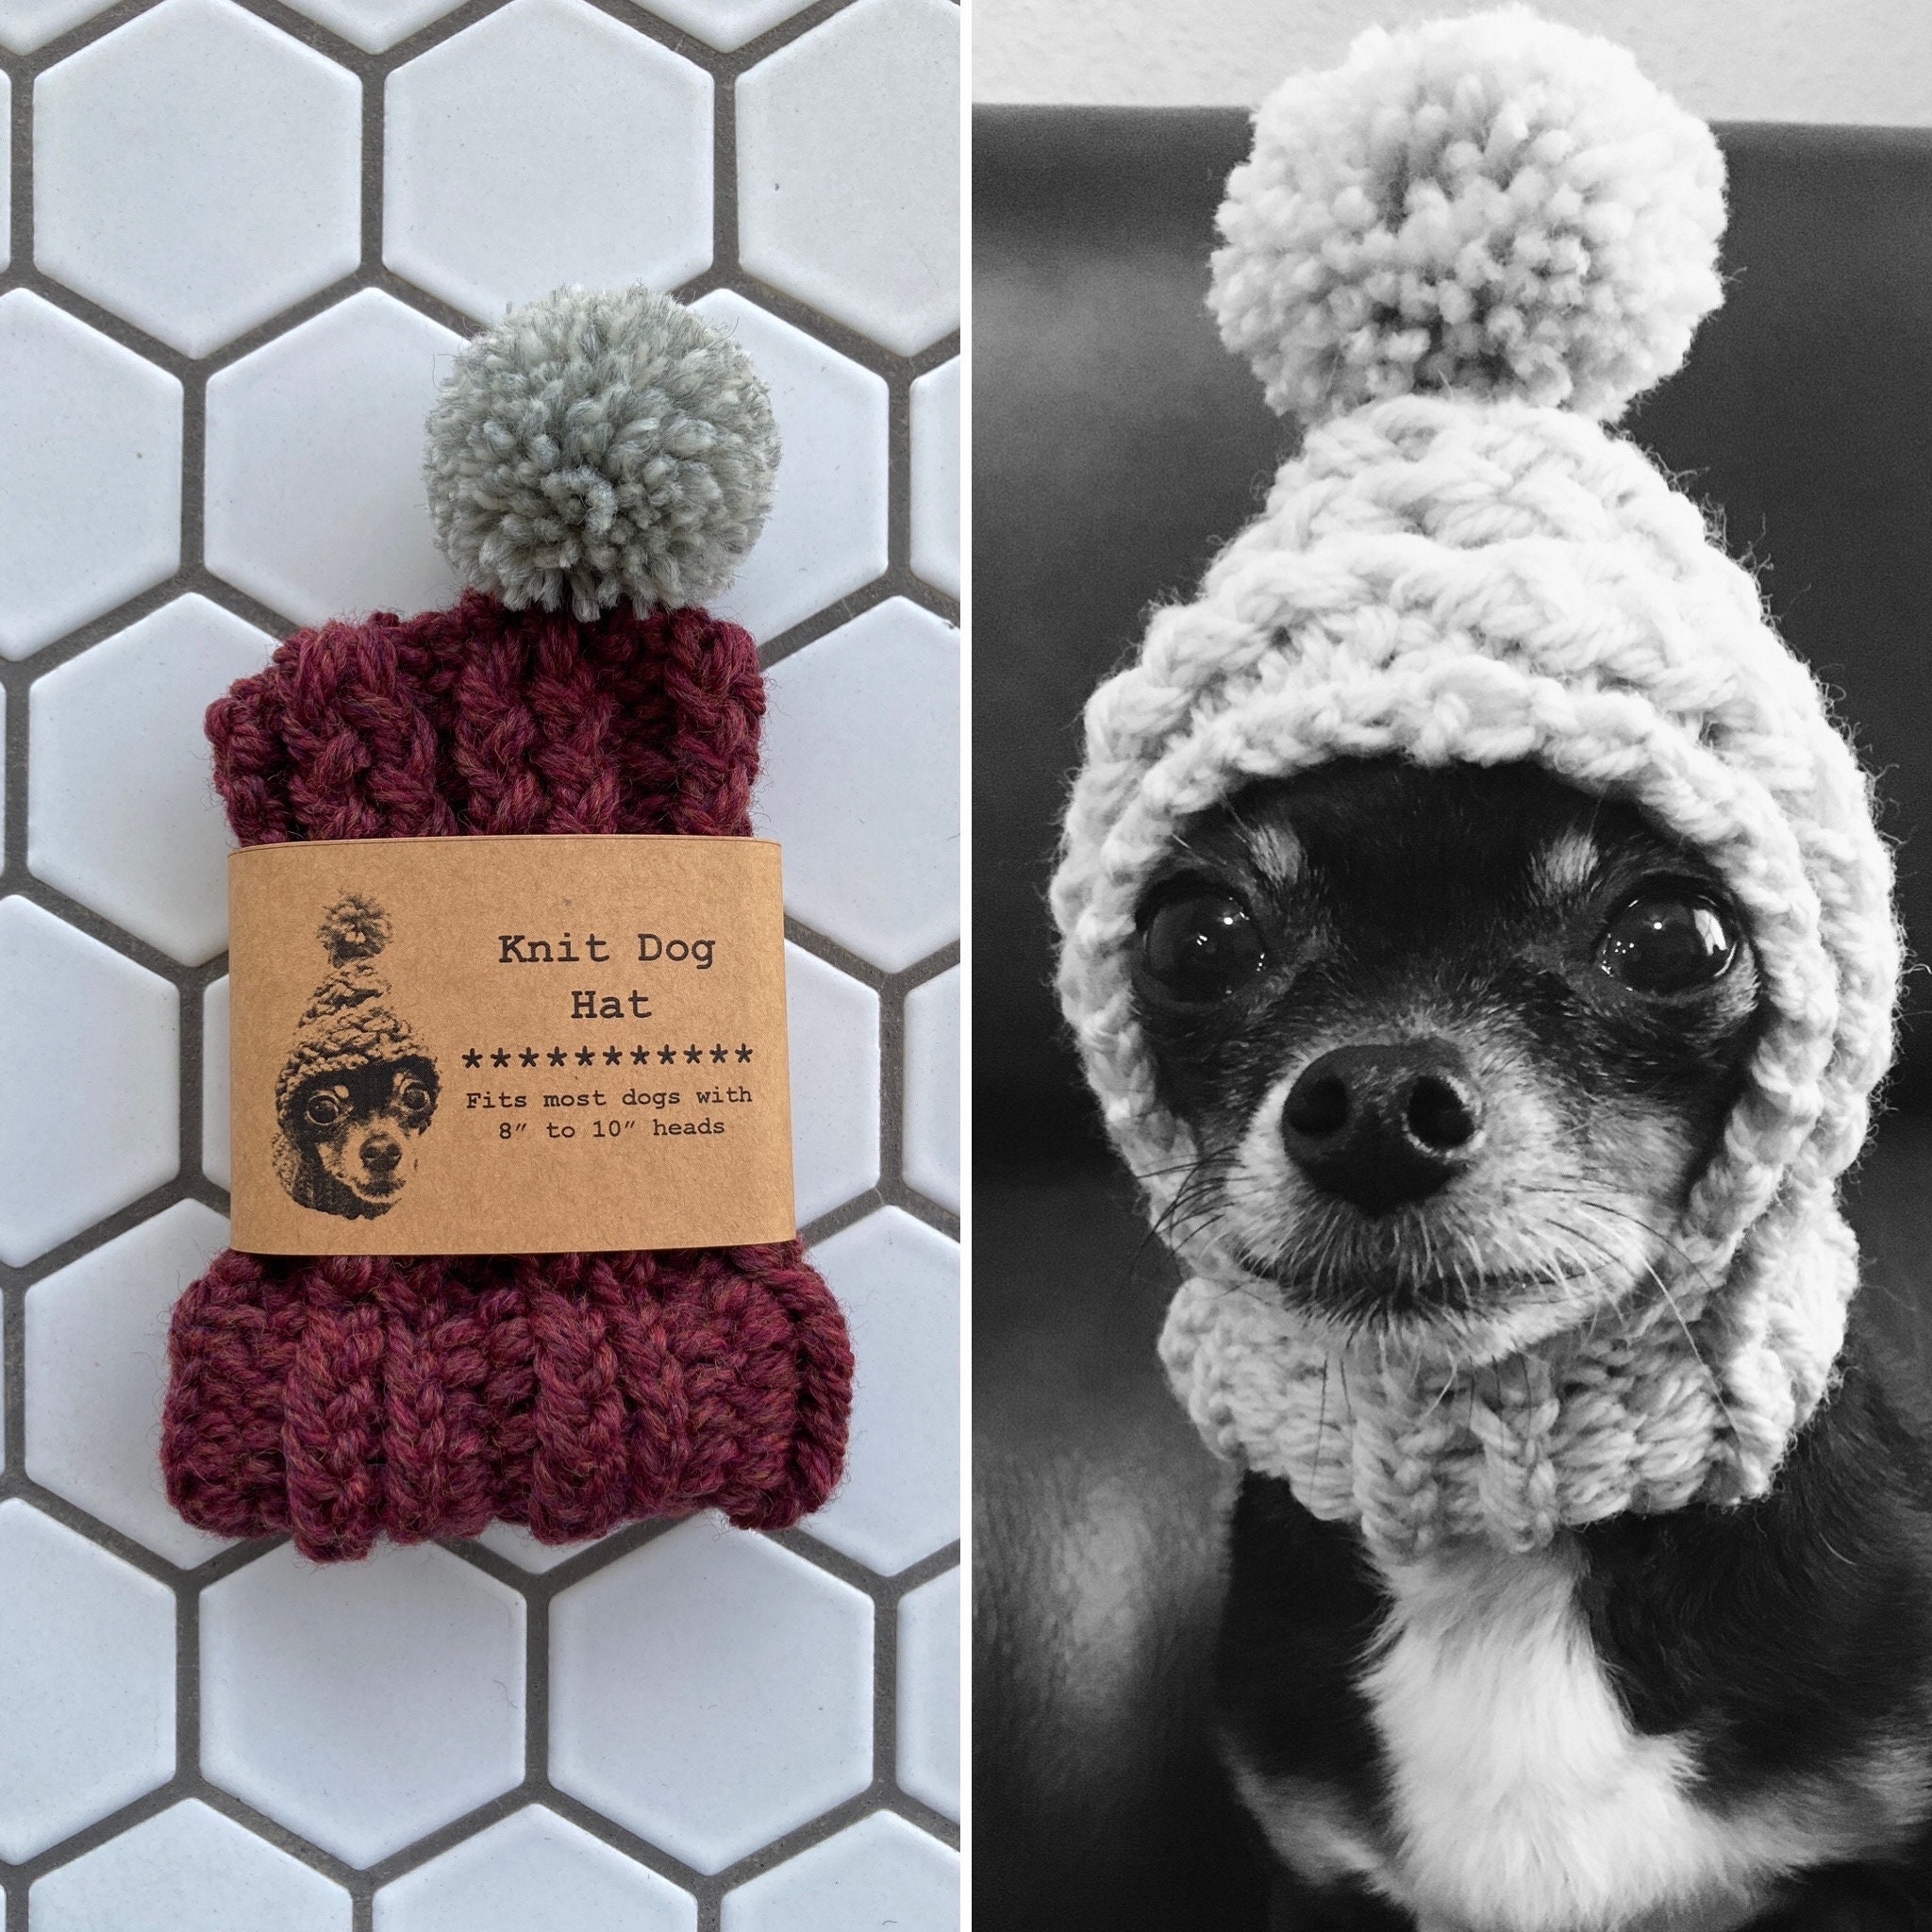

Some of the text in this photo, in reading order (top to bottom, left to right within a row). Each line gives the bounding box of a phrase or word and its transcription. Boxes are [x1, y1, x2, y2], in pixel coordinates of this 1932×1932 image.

[497, 933, 716, 970] Knit Dog
[570, 989, 653, 1020] Hat
[465, 1085, 754, 1110] Fits most dogs with
[545, 1122, 575, 1139] to
[652, 1117, 725, 1137] heads
